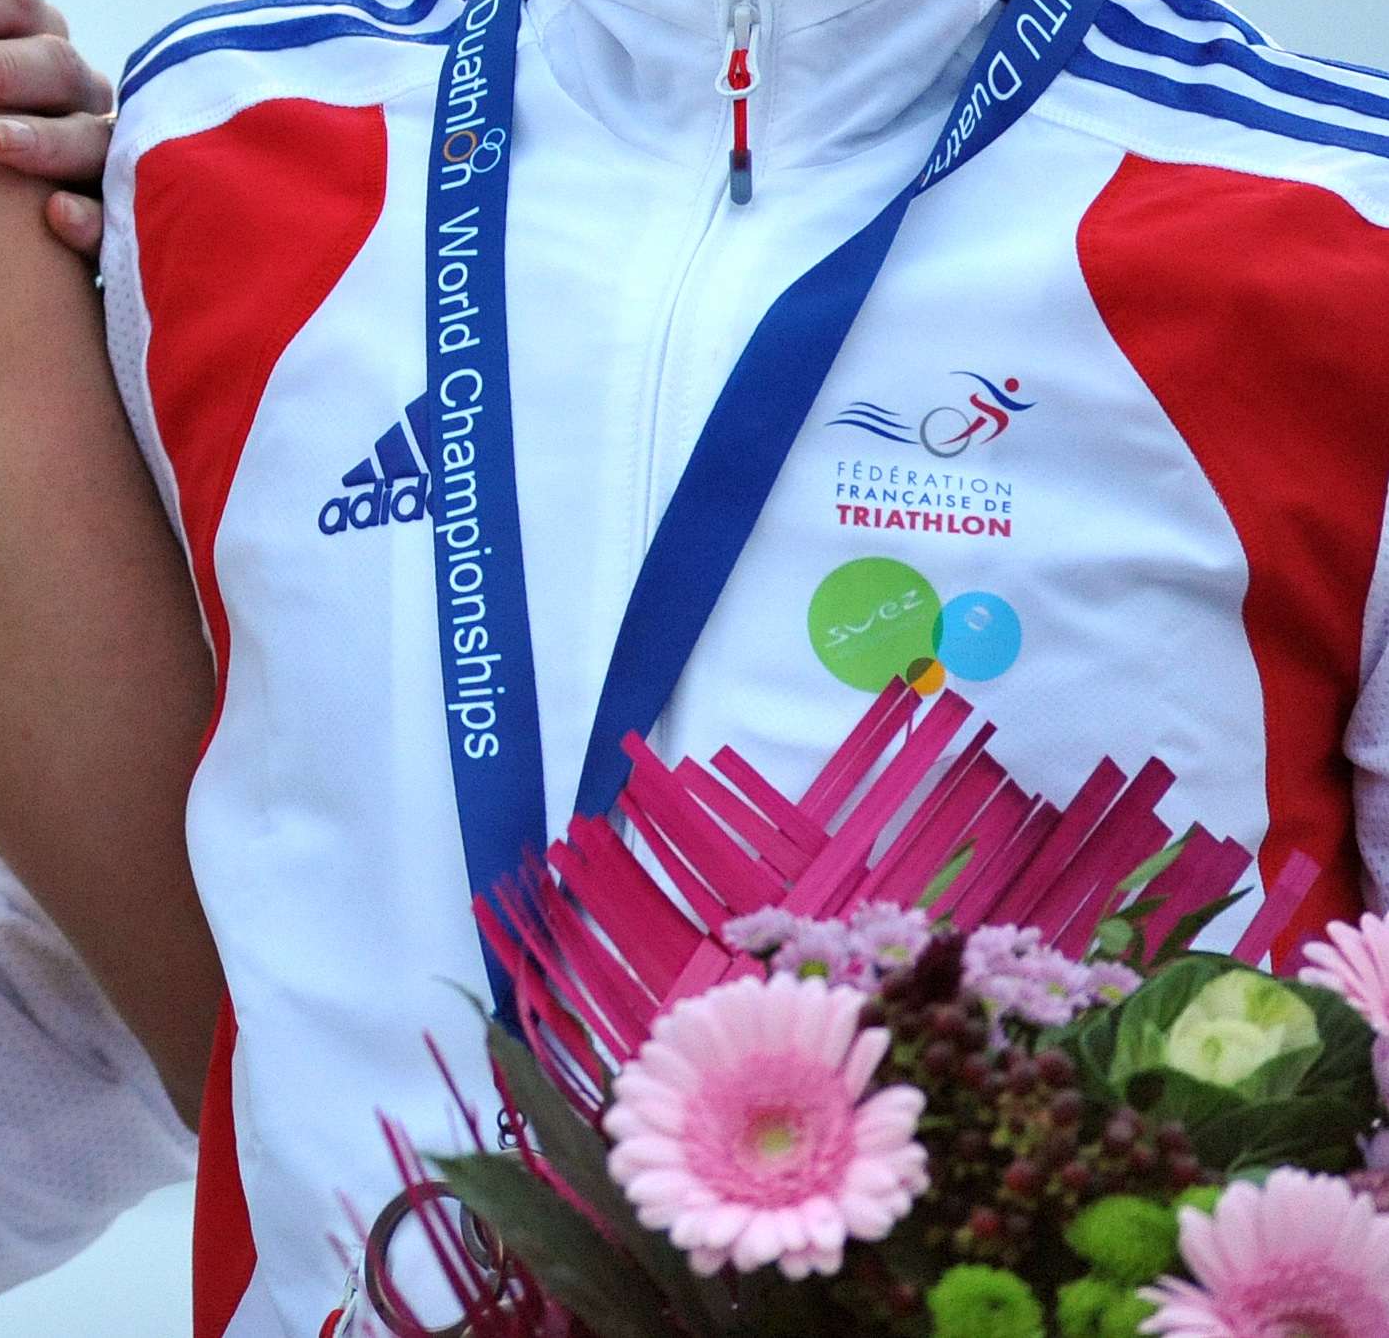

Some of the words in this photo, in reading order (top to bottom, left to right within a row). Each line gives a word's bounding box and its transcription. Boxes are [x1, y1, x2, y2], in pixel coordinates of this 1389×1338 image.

[437, 205, 482, 356] World
[835, 483, 970, 509] FRANÇAISE
[984, 499, 1012, 514] DE
[837, 460, 1013, 497] FÉDÉRATION
[318, 472, 438, 536] adid
[835, 503, 1012, 538] TRIATHLON
[435, 368, 507, 760] Championships
